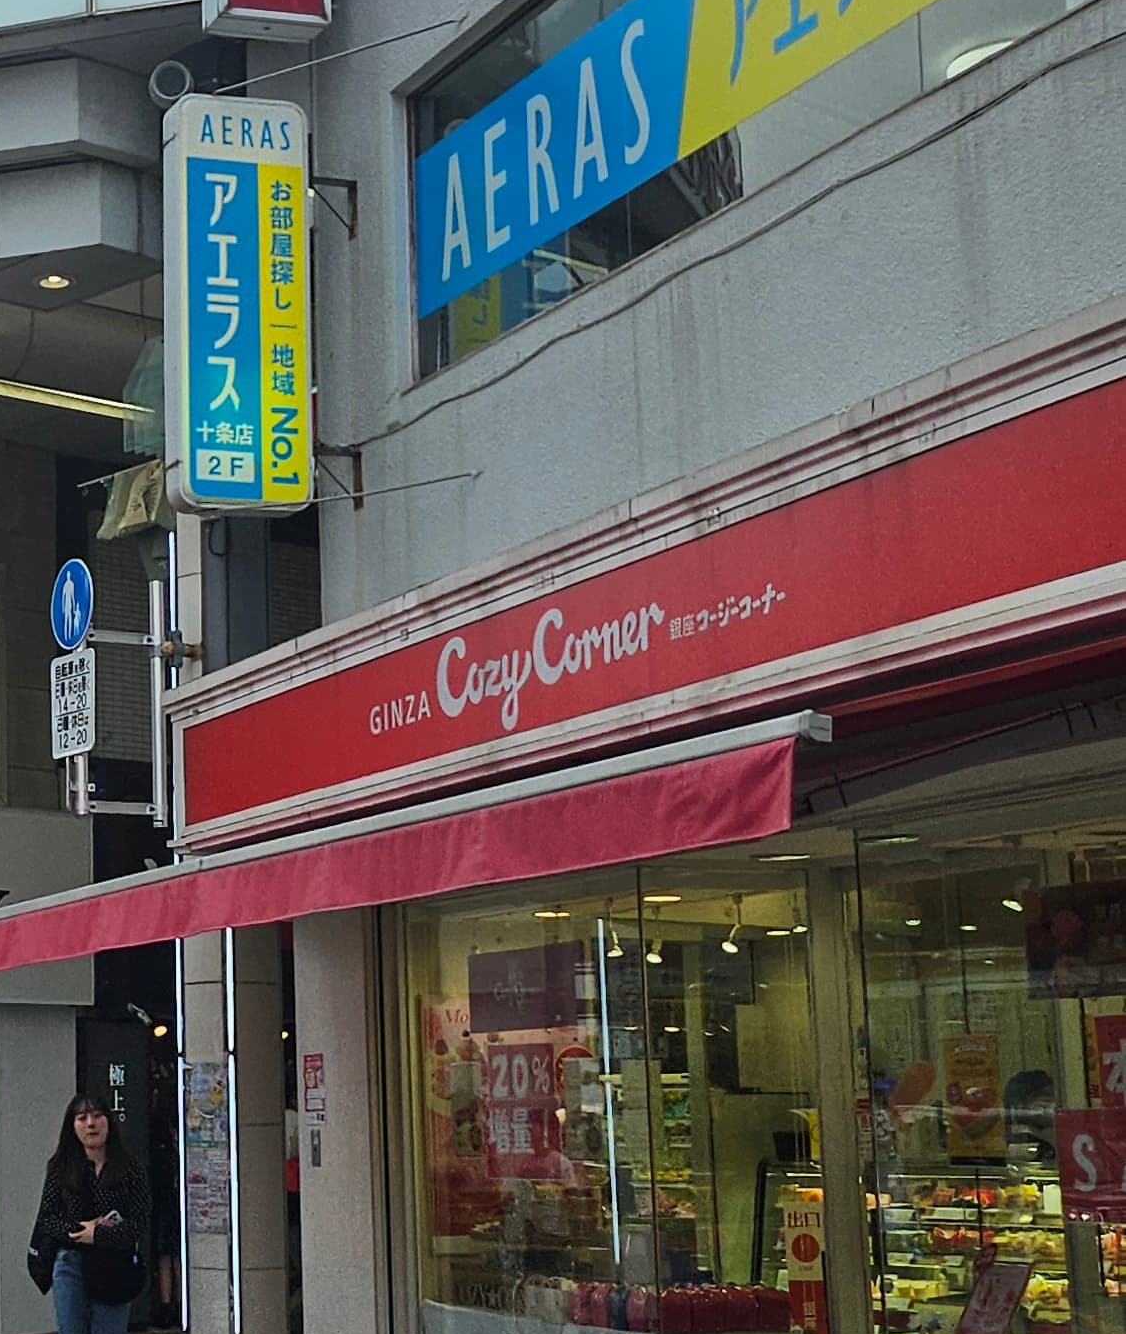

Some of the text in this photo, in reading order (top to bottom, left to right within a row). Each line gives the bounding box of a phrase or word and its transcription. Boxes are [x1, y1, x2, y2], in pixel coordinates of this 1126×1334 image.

[201, 114, 290, 151] AERAS
[442, 19, 650, 282] AERAS
[270, 180, 294, 310] お部屋探し
[205, 173, 240, 412] アエラス
[196, 420, 254, 445] 十条店
[208, 456, 244, 476] 2F
[669, 583, 785, 640] 銀座コージーコーナー
[370, 602, 664, 734] GINZA Cozy Corner
[58, 694, 87, 713] 14-20
[58, 729, 87, 750] 12-20
[490, 1053, 551, 1099] 20%
[787, 1211, 821, 1228] 出口
